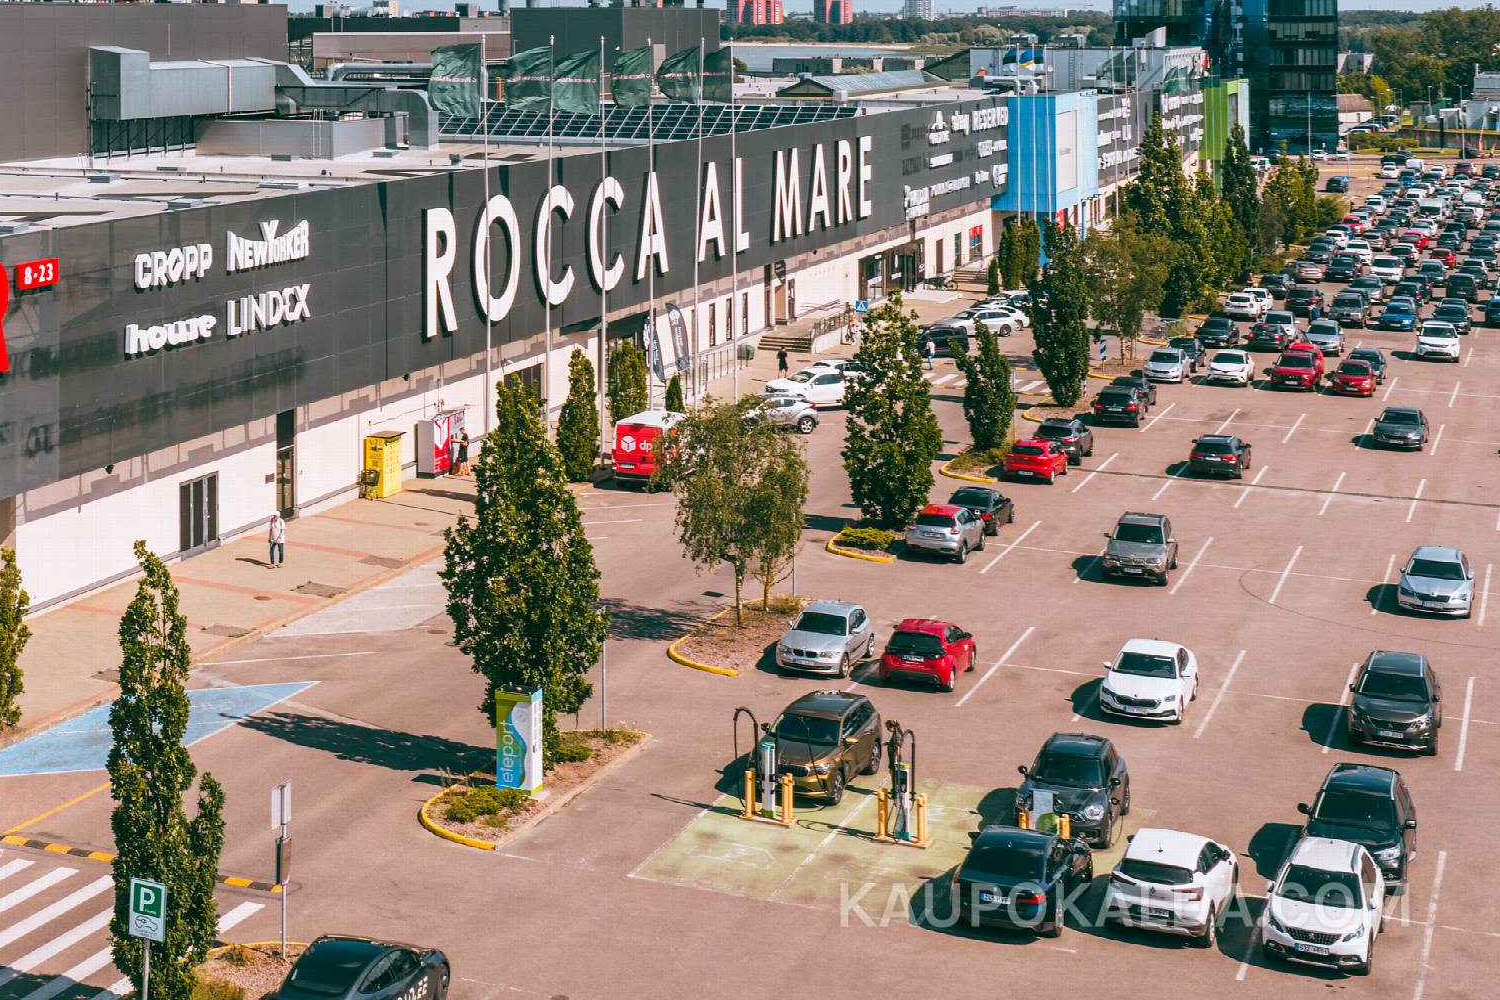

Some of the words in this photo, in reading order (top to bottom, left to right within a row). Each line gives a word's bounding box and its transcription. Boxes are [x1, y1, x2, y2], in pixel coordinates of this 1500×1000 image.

[425, 171, 669, 338] ROCCA
[697, 156, 750, 263] AL
[773, 135, 873, 242] MARE
[134, 243, 213, 289] CROPP
[226, 283, 312, 336] LINDEX
[639, 440, 654, 453] dp
[139, 886, 156, 912] P
